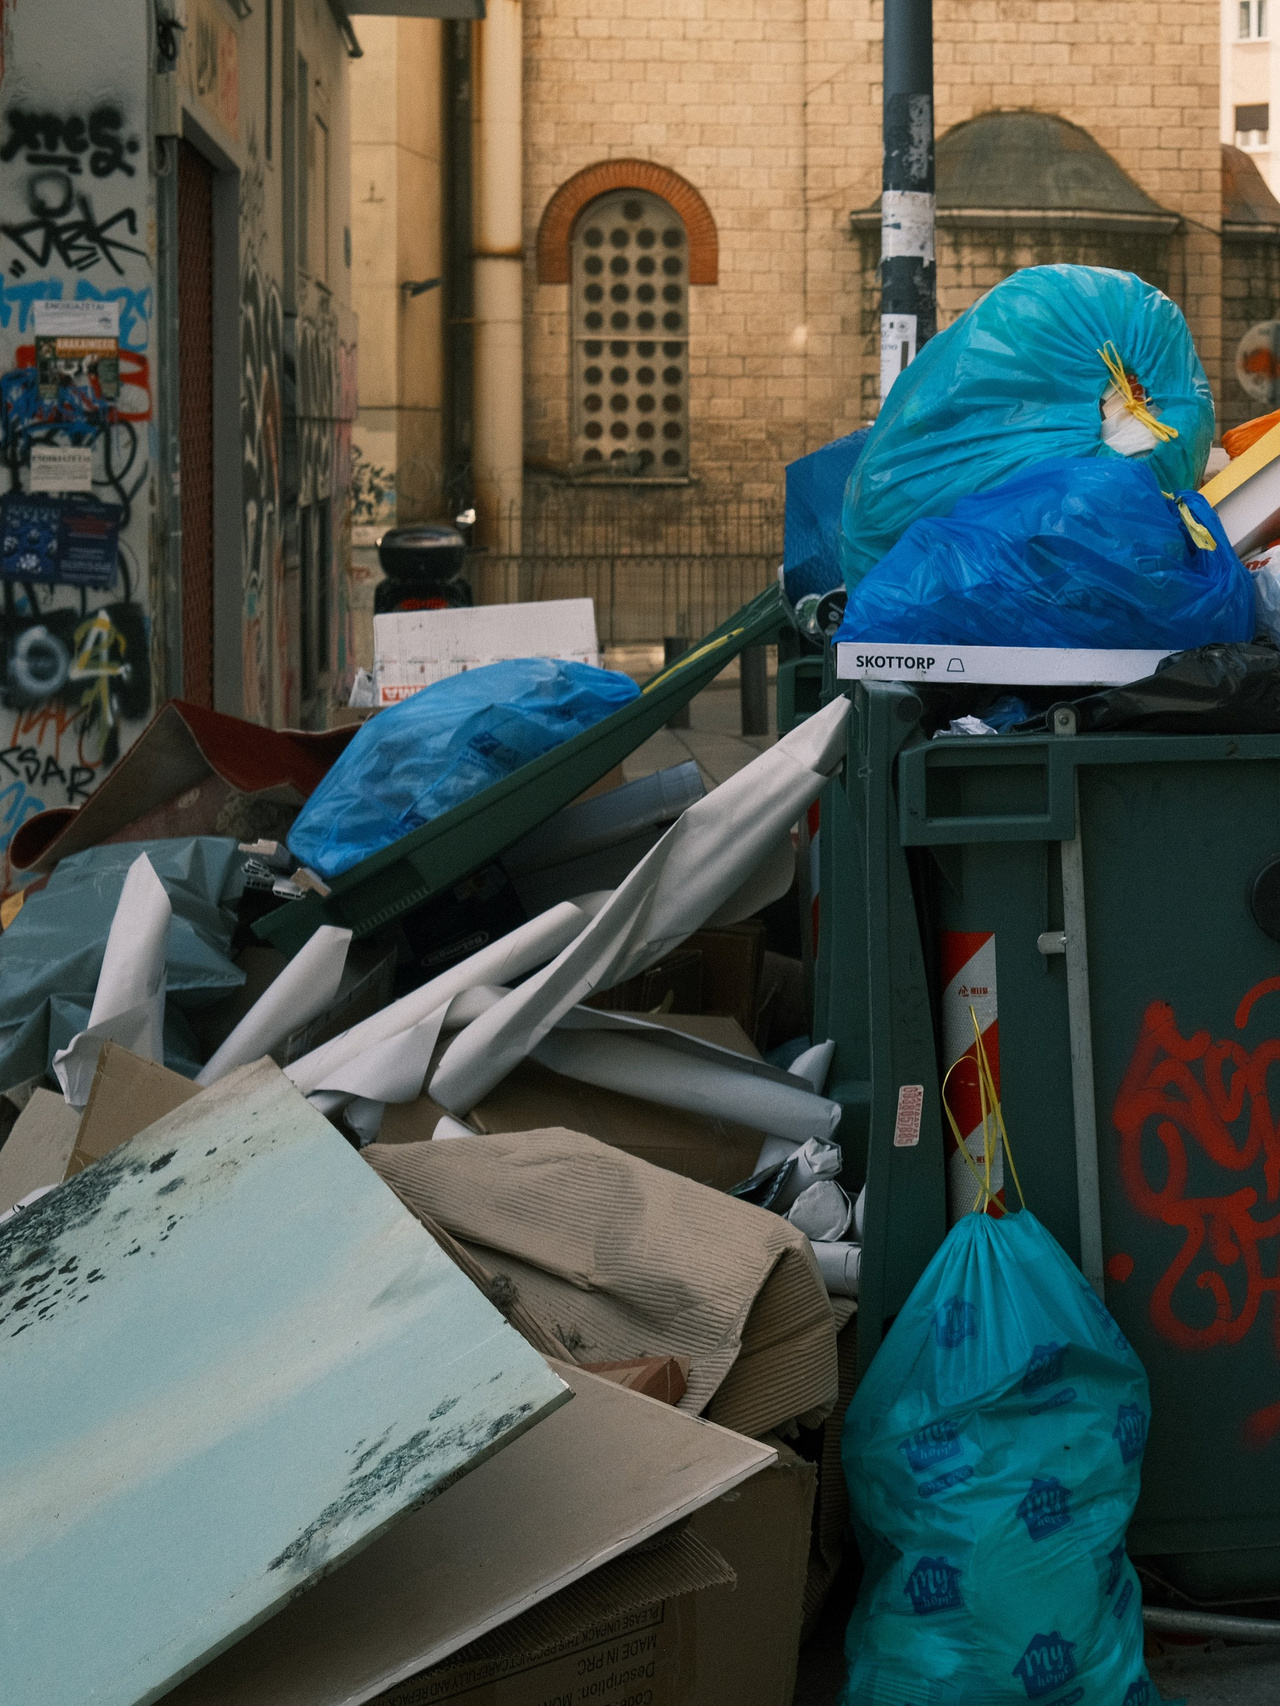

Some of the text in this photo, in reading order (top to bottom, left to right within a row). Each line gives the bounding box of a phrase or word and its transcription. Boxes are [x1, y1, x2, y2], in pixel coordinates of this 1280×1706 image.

[856, 655, 936, 670] SKOTTORP
[912, 1567, 950, 1597] My
[581, 1619, 621, 1644] UNPACK
[622, 1606, 660, 1631] PLEASE
[577, 1633, 657, 1676] MADE IN PRC
[1024, 1643, 1064, 1678] My
[429, 1679, 450, 1697] AND
[450, 1659, 510, 1689] CAREFULLY
[577, 1662, 656, 1700] Description:
